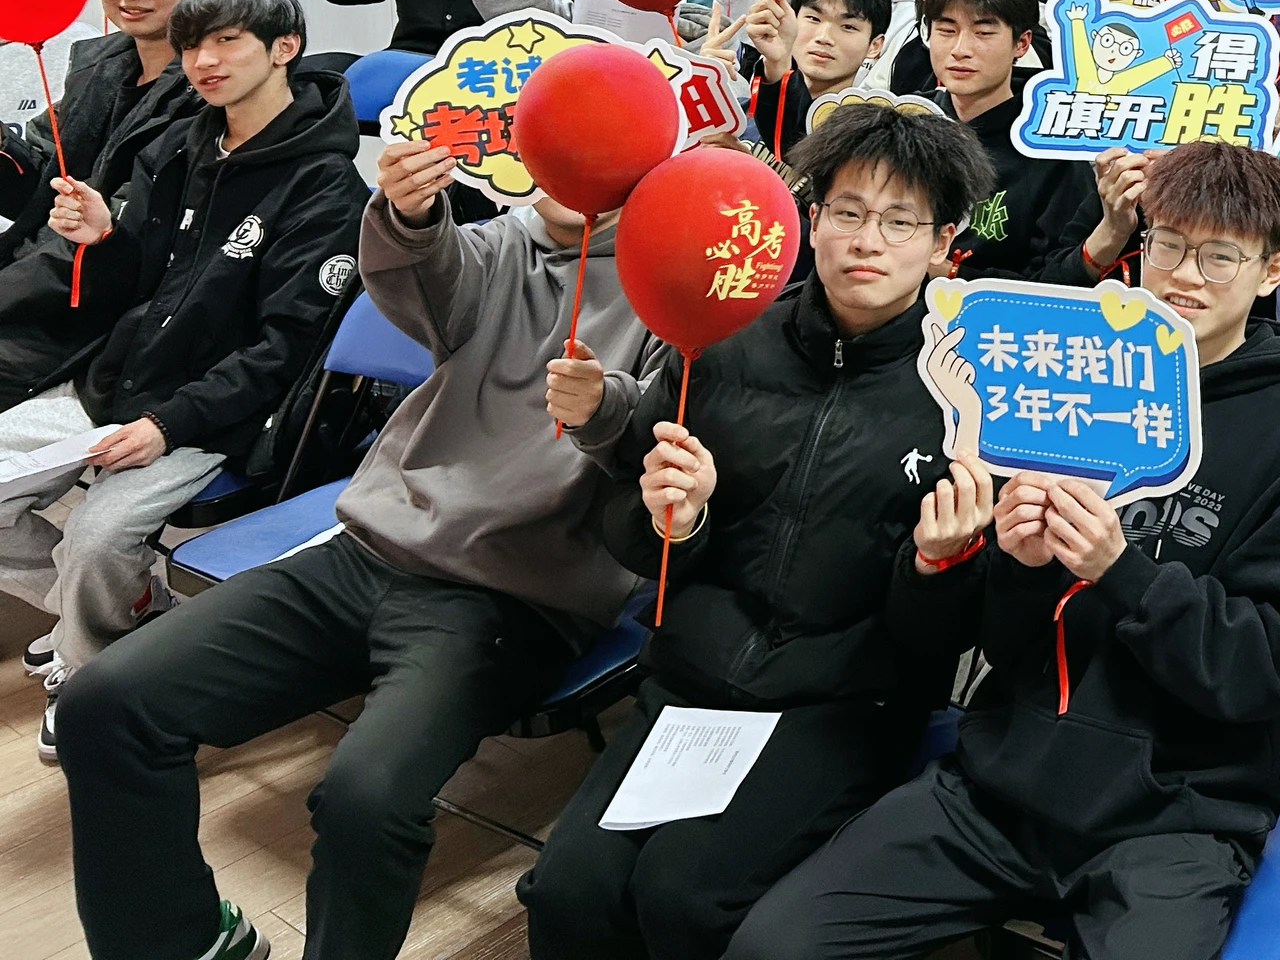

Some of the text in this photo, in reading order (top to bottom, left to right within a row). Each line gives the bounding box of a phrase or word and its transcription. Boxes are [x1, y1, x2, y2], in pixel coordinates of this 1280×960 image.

[977, 325, 1156, 393] 未来我们
[985, 385, 1175, 449] 3年不一样
[1193, 495, 1222, 512] 2023
[1202, 488, 1225, 503] DAY
